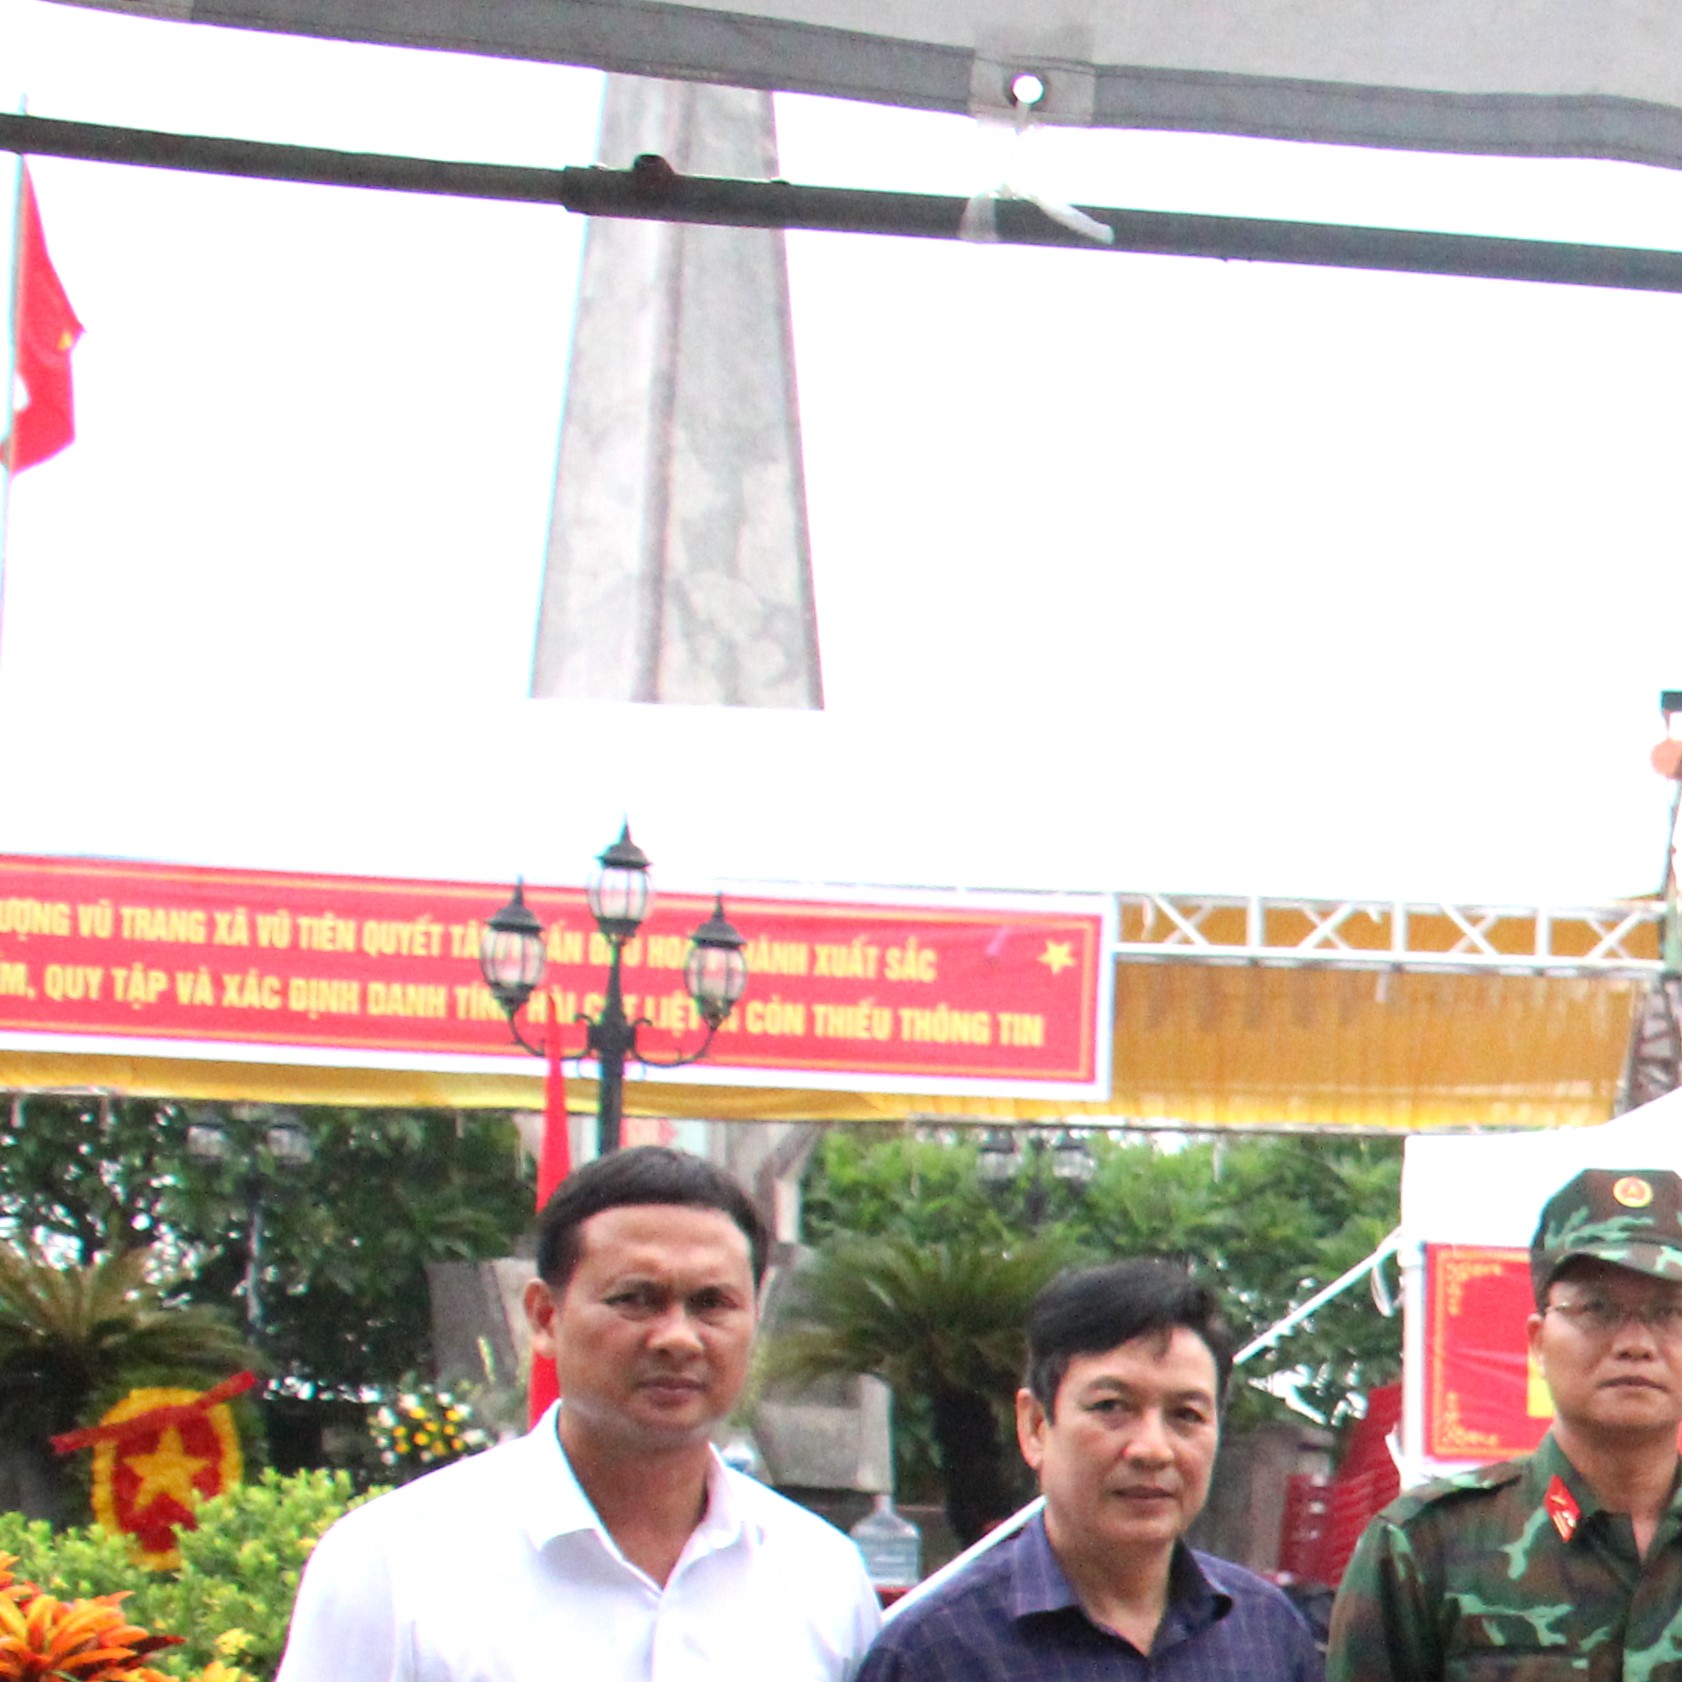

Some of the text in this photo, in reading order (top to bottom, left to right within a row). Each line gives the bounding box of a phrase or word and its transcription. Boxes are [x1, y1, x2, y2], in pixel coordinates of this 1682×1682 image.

[77, 898, 113, 940] VŨ
[120, 905, 207, 945] TRANG
[213, 906, 250, 947] XÃ
[256, 908, 292, 949] VŨ
[297, 911, 356, 953] TIÊN
[362, 914, 443, 958] QUYẾT
[813, 934, 880, 980] XUẤT
[884, 936, 938, 984] SẮC
[44, 964, 104, 1002] QUY
[110, 962, 170, 1010] TẬP
[175, 965, 216, 1008] VÀ
[222, 968, 283, 1011] XÁC
[288, 976, 361, 1021] ĐỊNH
[367, 981, 448, 1020] DANH
[455, 982, 510, 1023] TÍN
[583, 992, 638, 1026] CT
[746, 993, 807, 1038] CÒN
[812, 998, 893, 1042] THIẾU
[898, 1003, 992, 1046] THÔNG
[997, 1012, 1044, 1047] TIN
